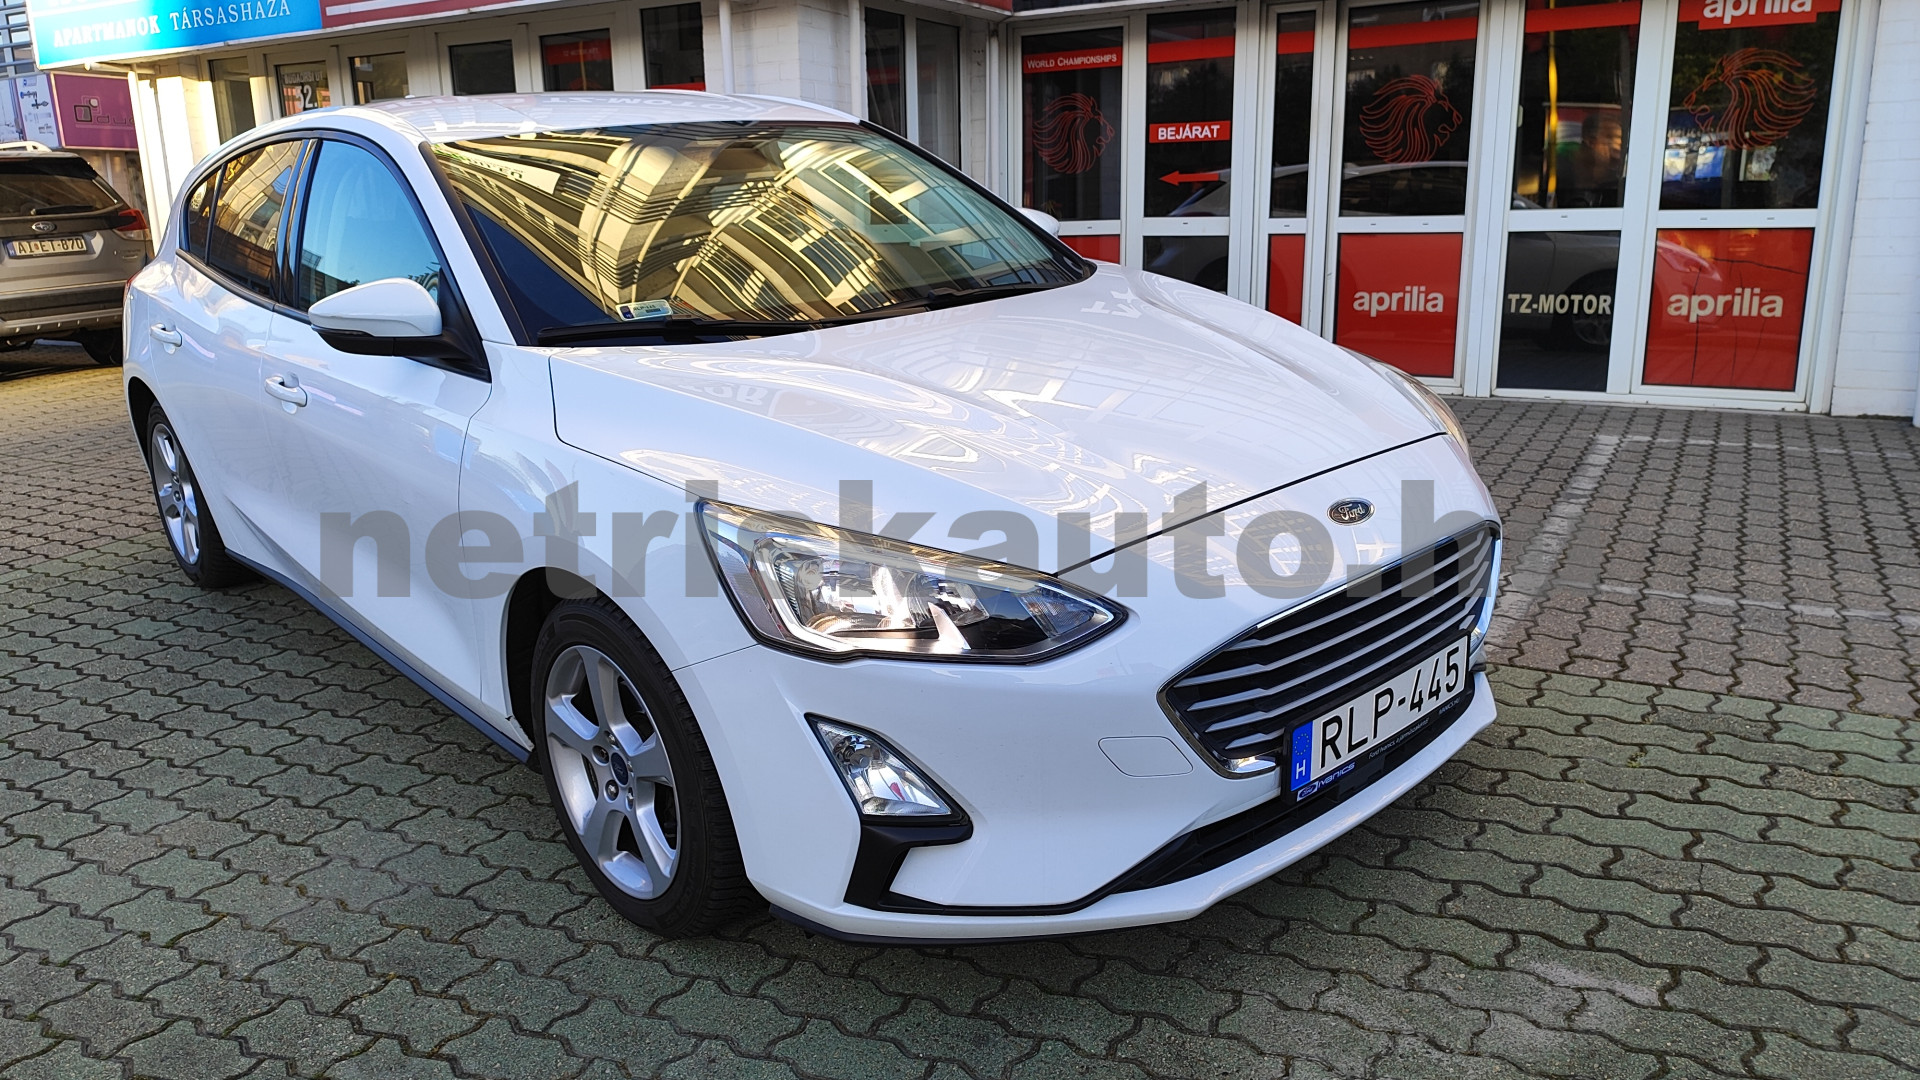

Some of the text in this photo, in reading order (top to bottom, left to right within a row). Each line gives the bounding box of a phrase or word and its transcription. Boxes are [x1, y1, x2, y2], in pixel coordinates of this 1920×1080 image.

[53, 16, 160, 48] APARTMANOK
[1027, 54, 1117, 69] WORLD CHAMPIONSHIPS
[1158, 123, 1220, 140] BEJÁRAT
[18, 241, 35, 254] AI
[1353, 285, 1444, 317] aprilia
[1508, 294, 1612, 315] TZ-MOTOR
[1667, 287, 1784, 323] aprilia
[1320, 645, 1460, 770] RLP-445
[1295, 758, 1306, 780] H
